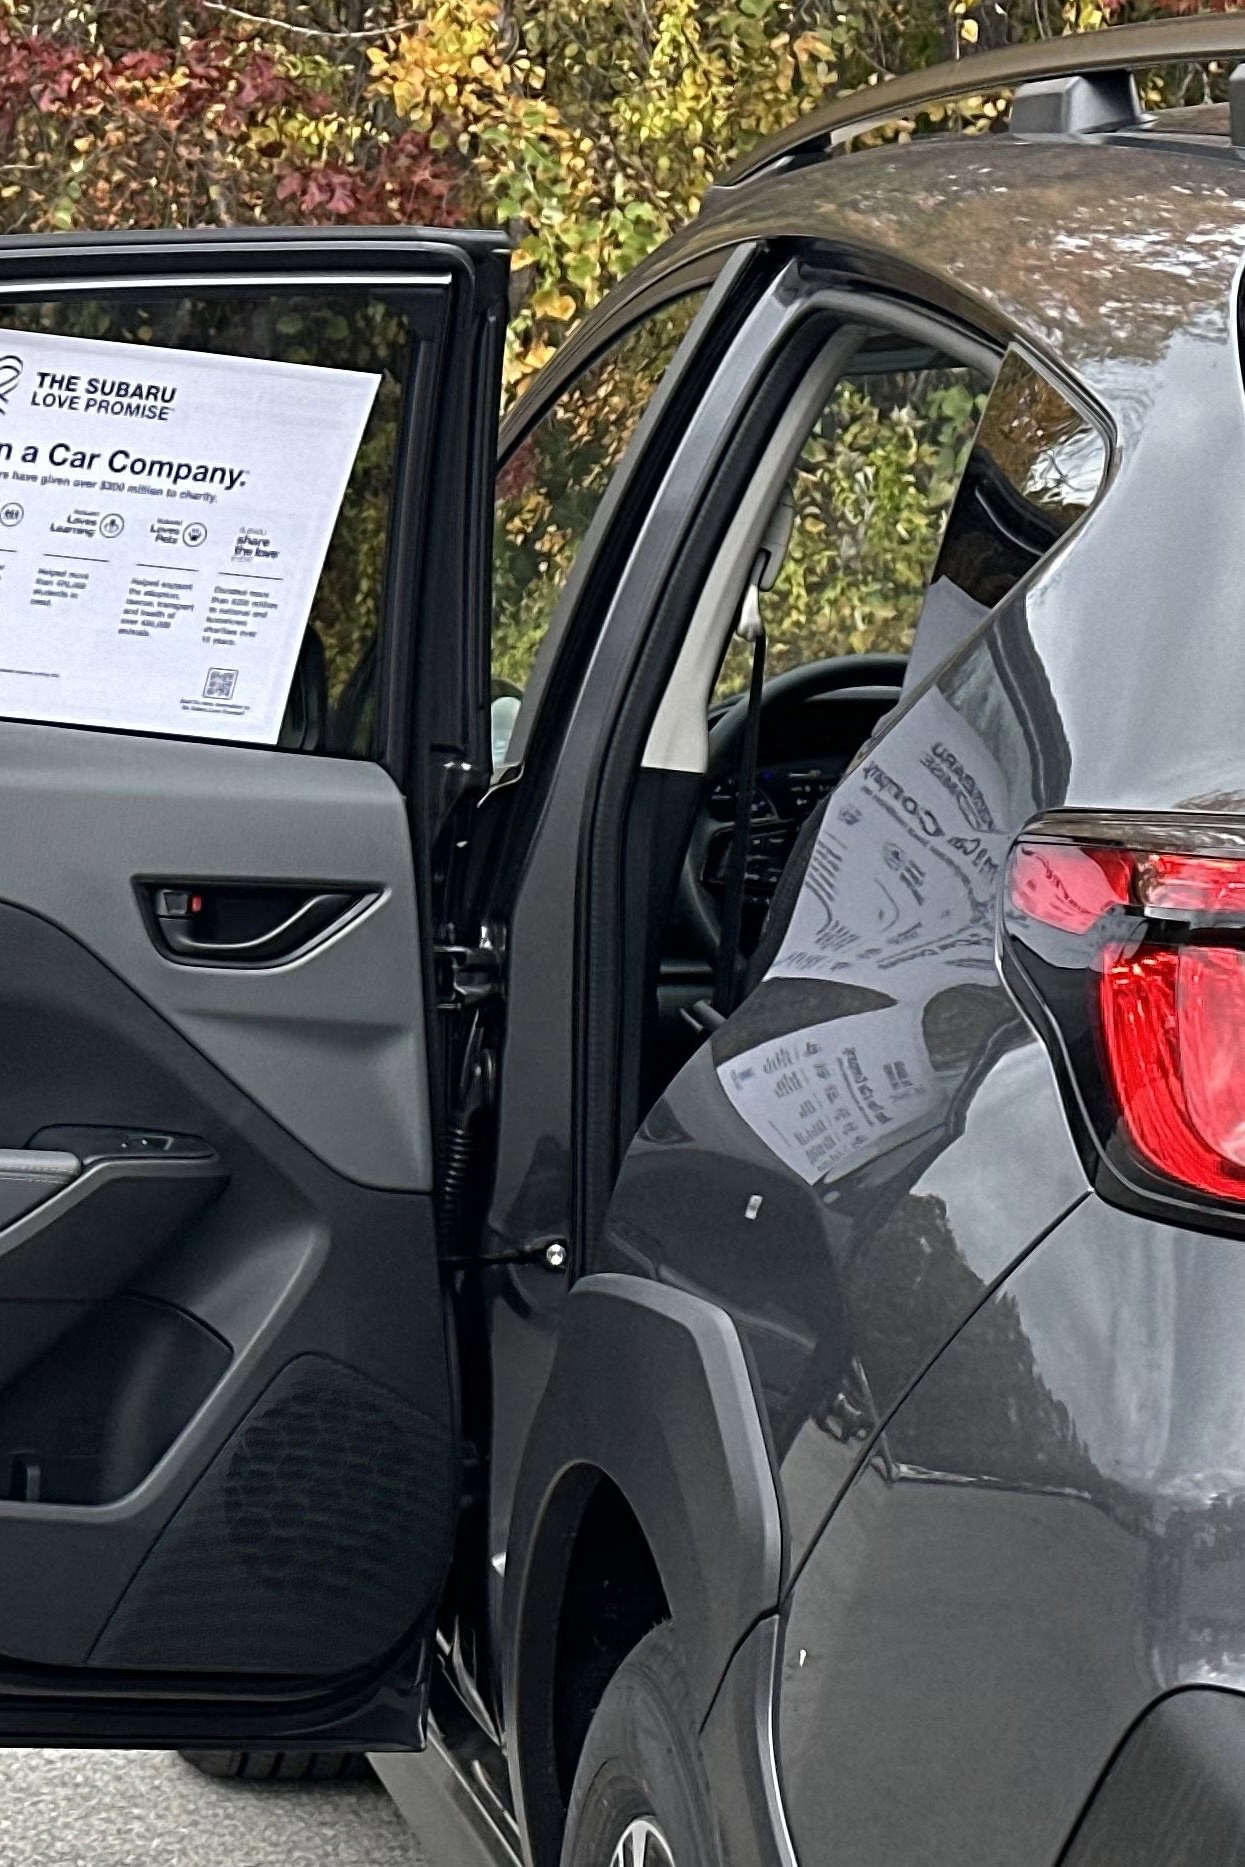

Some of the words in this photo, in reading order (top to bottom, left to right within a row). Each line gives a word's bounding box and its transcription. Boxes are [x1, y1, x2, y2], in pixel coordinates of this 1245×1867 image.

[34, 372, 80, 391] THE
[84, 378, 177, 403] SUBARU
[29, 391, 81, 410] LOVE
[83, 398, 171, 421] PROMISE
[20, 444, 40, 463] a
[46, 442, 102, 470] Car
[11, 470, 39, 481] have
[40, 474, 70, 487] given
[72, 480, 96, 488] over
[127, 483, 163, 495] million
